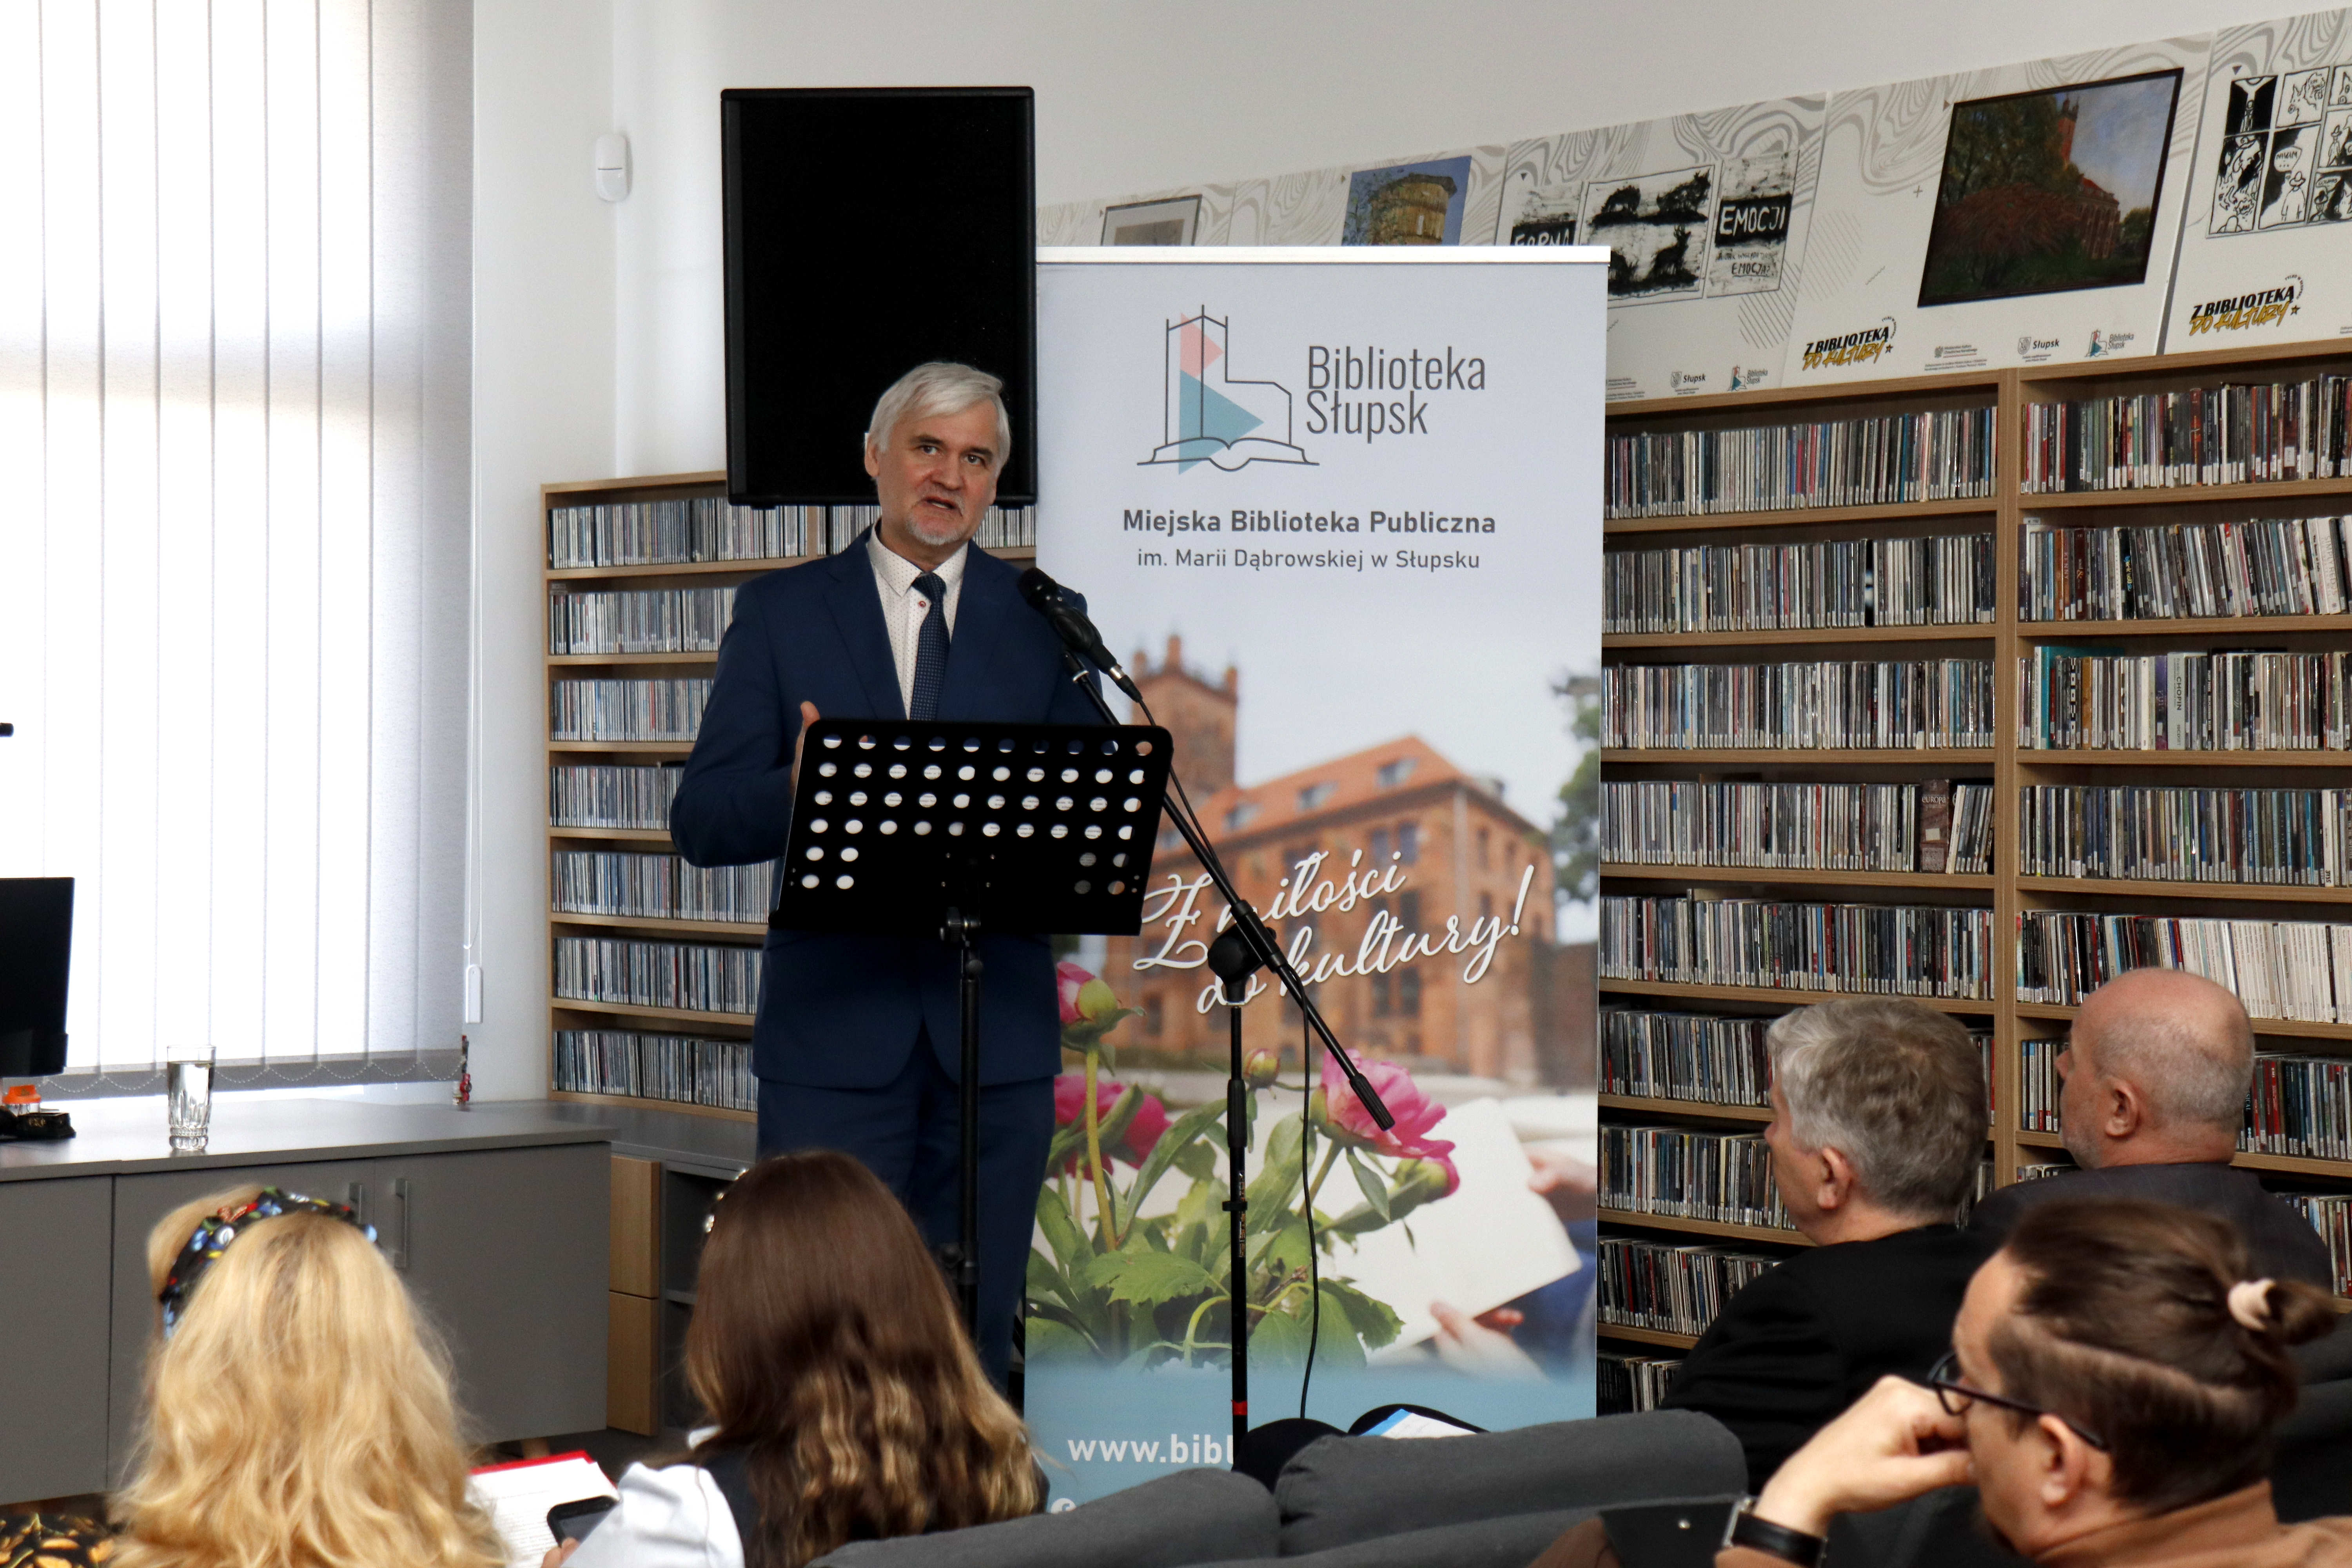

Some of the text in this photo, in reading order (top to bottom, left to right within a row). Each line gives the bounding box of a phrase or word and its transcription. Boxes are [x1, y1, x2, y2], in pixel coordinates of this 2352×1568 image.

[1719, 205, 1786, 236] EMOCJI
[2191, 304, 2203, 320] Z
[2204, 285, 2294, 317] BIBLIOTEKĄ
[2189, 301, 2291, 336] DO KULTURY
[1802, 340, 1885, 371] DO KULTURY
[1804, 343, 1814, 357] Z
[1815, 327, 1889, 354] BIBLIOTEKĄ
[2033, 339, 2060, 350] Słupsk
[1308, 346, 1486, 390] Biblioteka
[1683, 374, 1706, 384] Słupsk
[1307, 390, 1429, 445] Słupsk
[1123, 509, 1496, 537] Miejska Biblioteka Publiczna
[1138, 549, 1480, 572] im. Marii Dąbrowskiej w Słupsku
[1133, 873, 1214, 970] Z
[1279, 864, 1534, 997] kultury!
